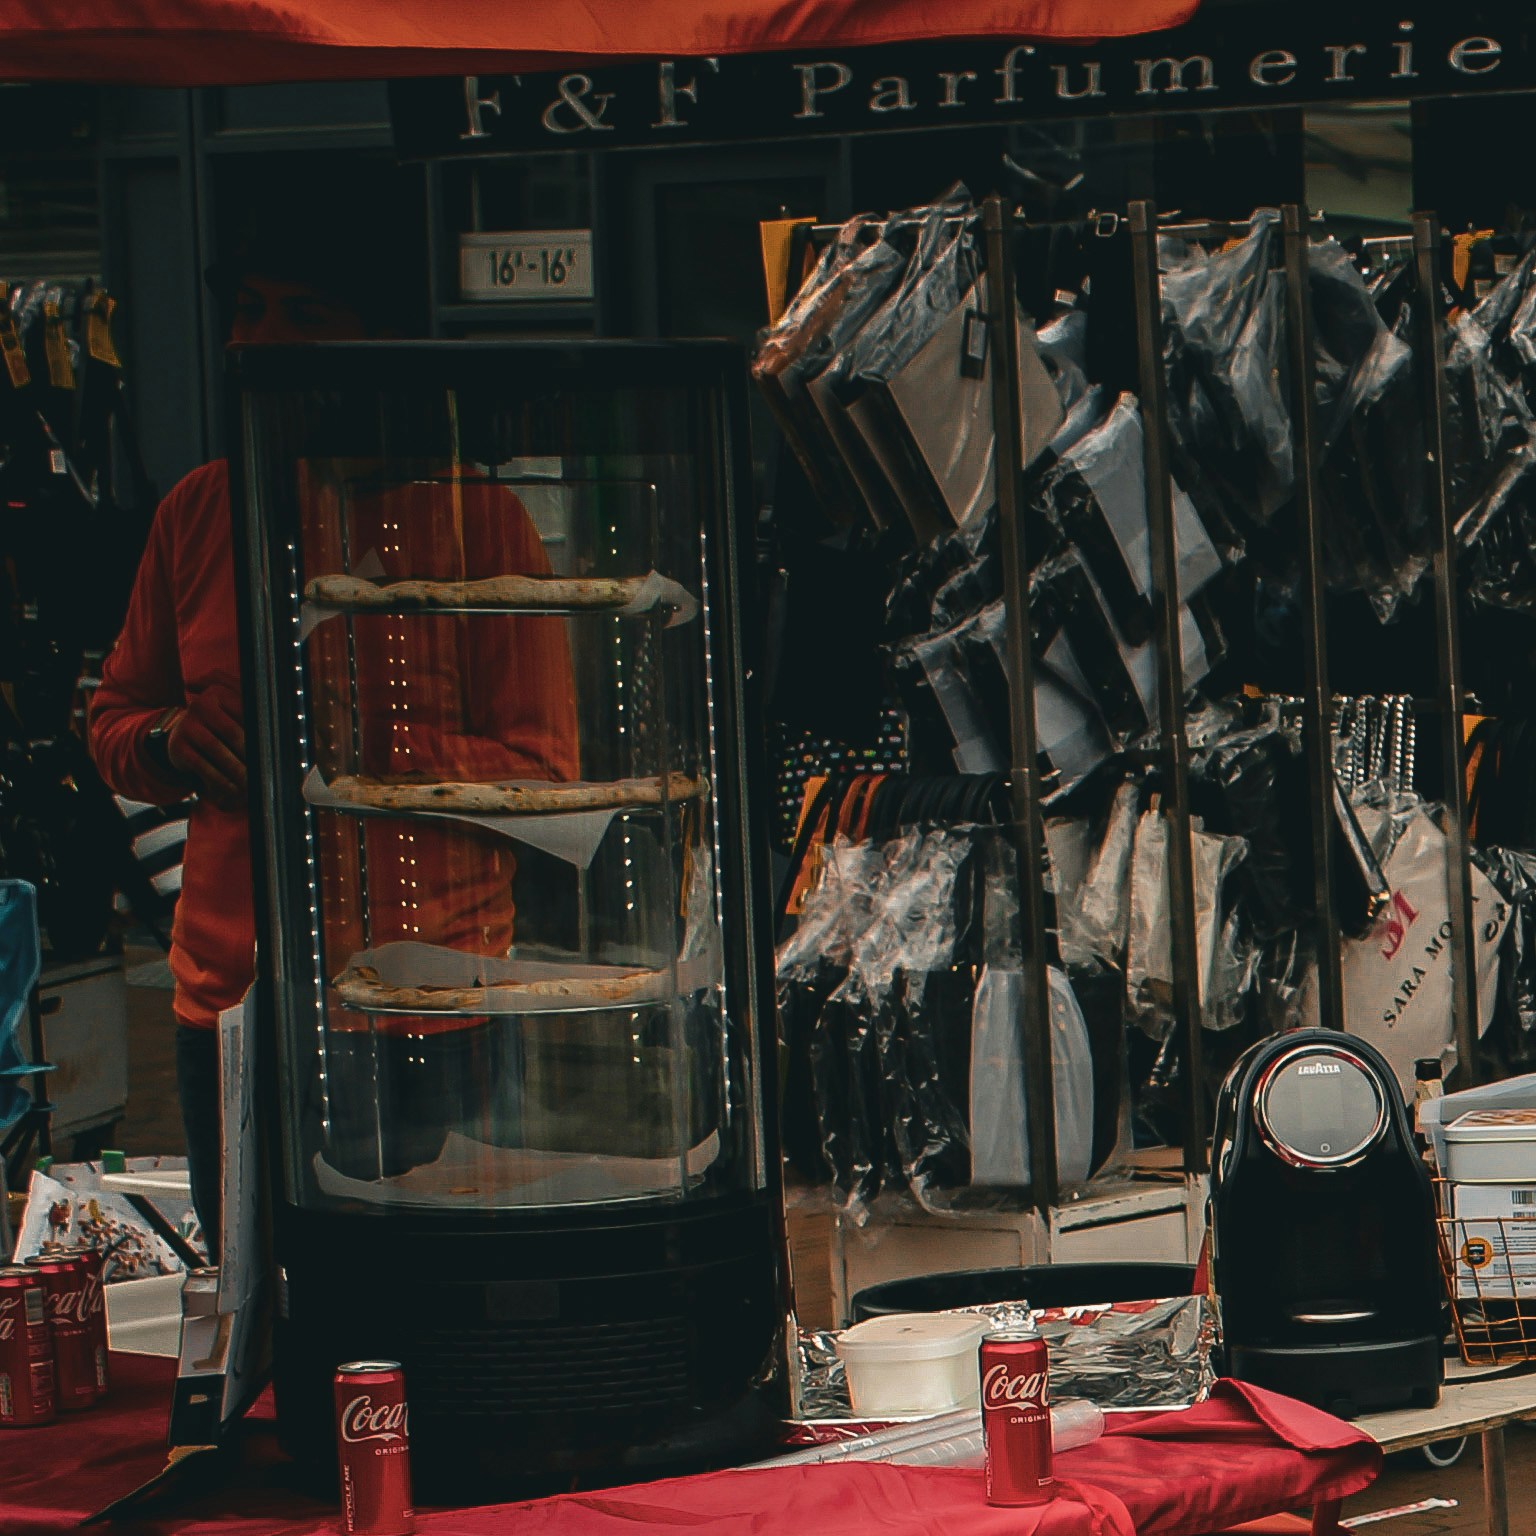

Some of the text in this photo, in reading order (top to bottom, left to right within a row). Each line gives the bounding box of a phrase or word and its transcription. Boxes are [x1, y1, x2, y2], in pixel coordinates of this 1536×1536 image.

[541, 73, 614, 135] &
[651, 58, 721, 128] F
[793, 22, 1502, 118] Parfumerie
[1383, 965, 1427, 1029] SARA
[1297, 1062, 1342, 1076] LAVAZZA
